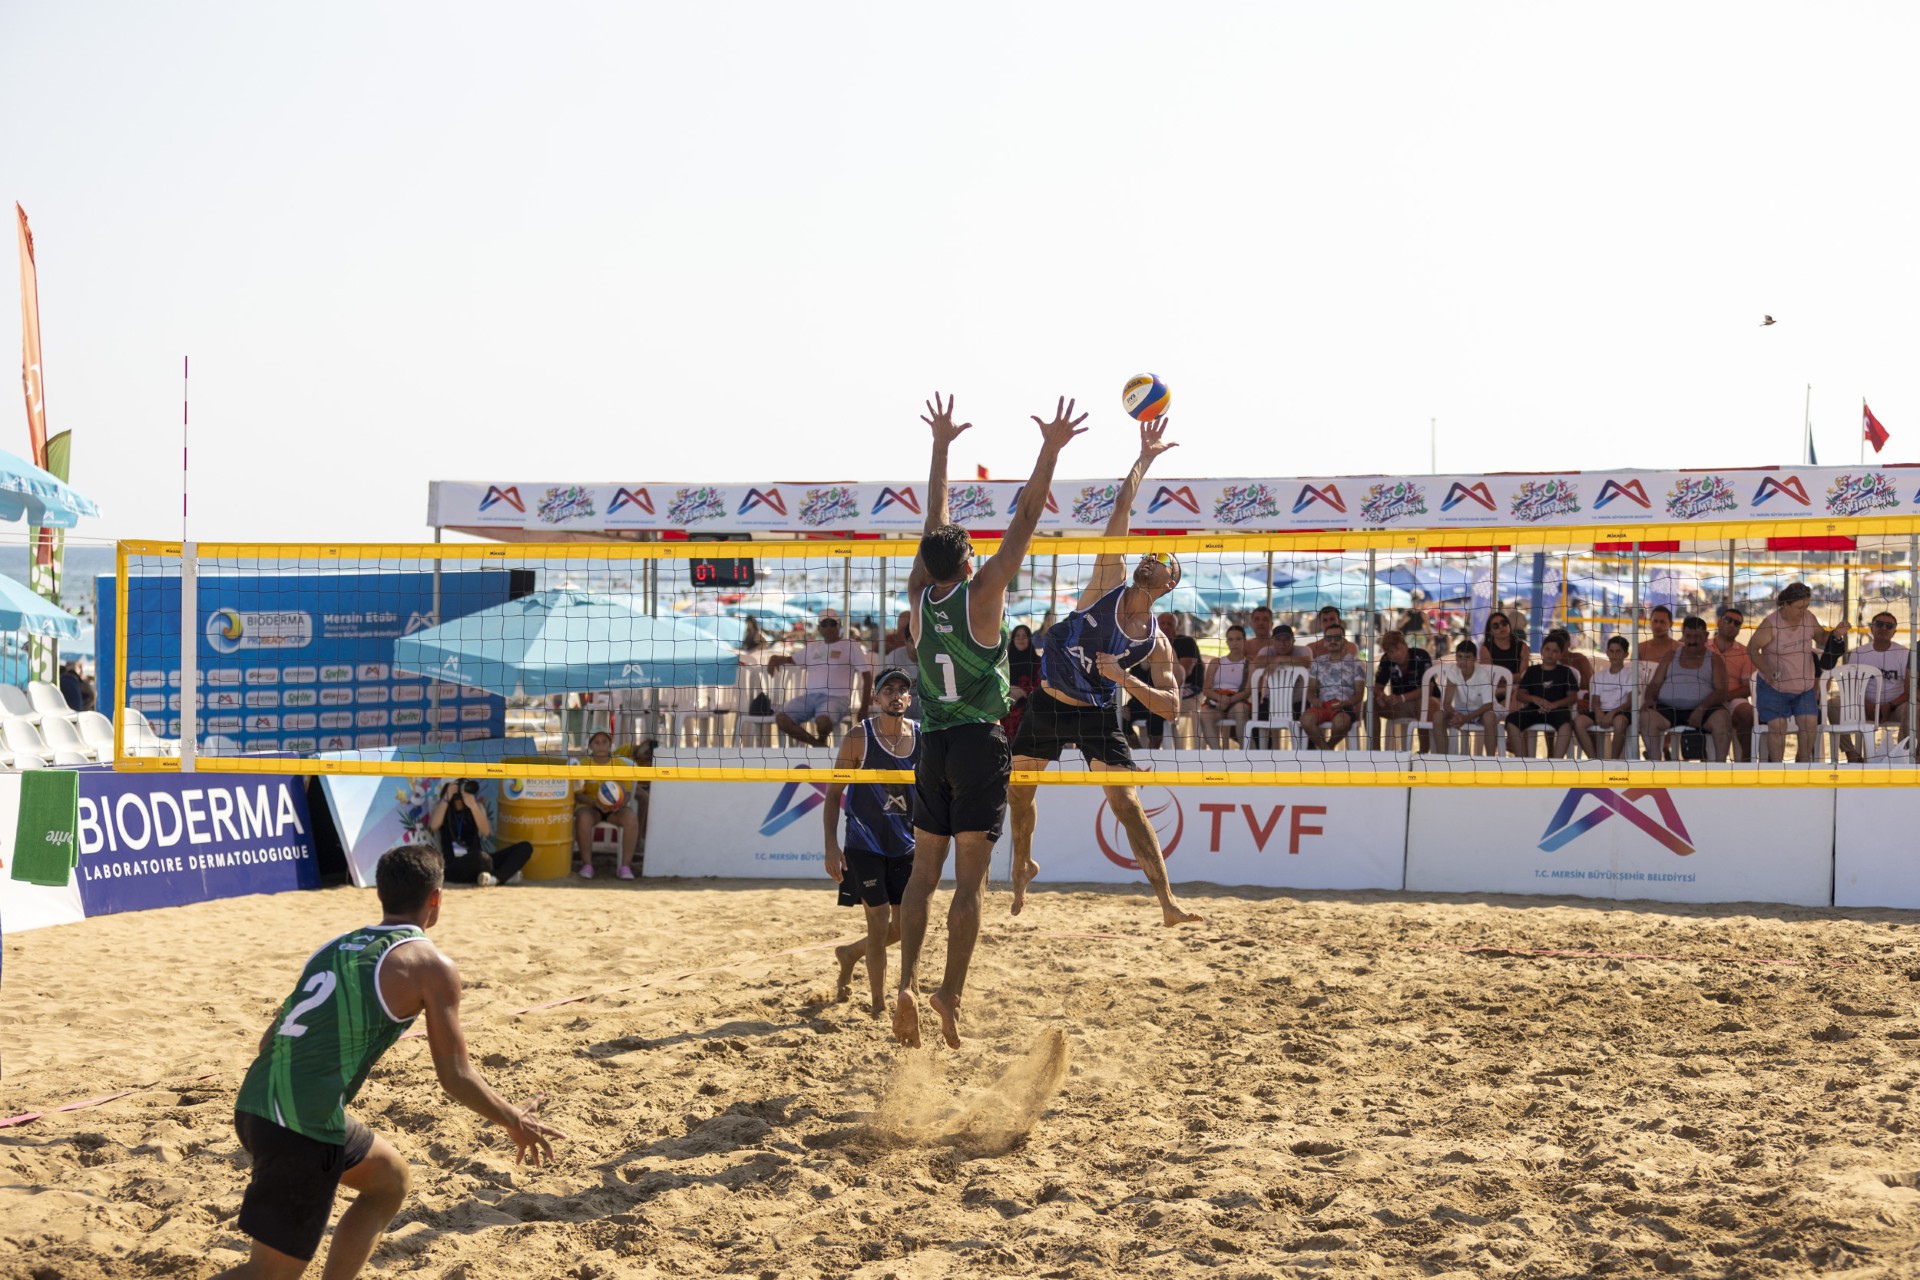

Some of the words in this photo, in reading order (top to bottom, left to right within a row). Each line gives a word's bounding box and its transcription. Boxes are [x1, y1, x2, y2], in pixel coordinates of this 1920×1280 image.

[247, 616, 305, 626] BIODERMA
[323, 612, 363, 624] Mersin
[935, 654, 962, 703] 1
[79, 783, 304, 854] BIODERMA
[1199, 803, 1327, 854] TVF
[84, 856, 184, 881] LABORATOIRE
[190, 845, 309, 870] DERMATOLOGIQUE
[768, 851, 798, 861] MERSİN
[1534, 869, 1549, 878] T.C.
[1551, 869, 1585, 879] MERSİN
[1588, 870, 1645, 882] BÜYÜKŞEHİR
[1647, 872, 1696, 883] BELEDİYESİ
[277, 970, 337, 1038] 2
